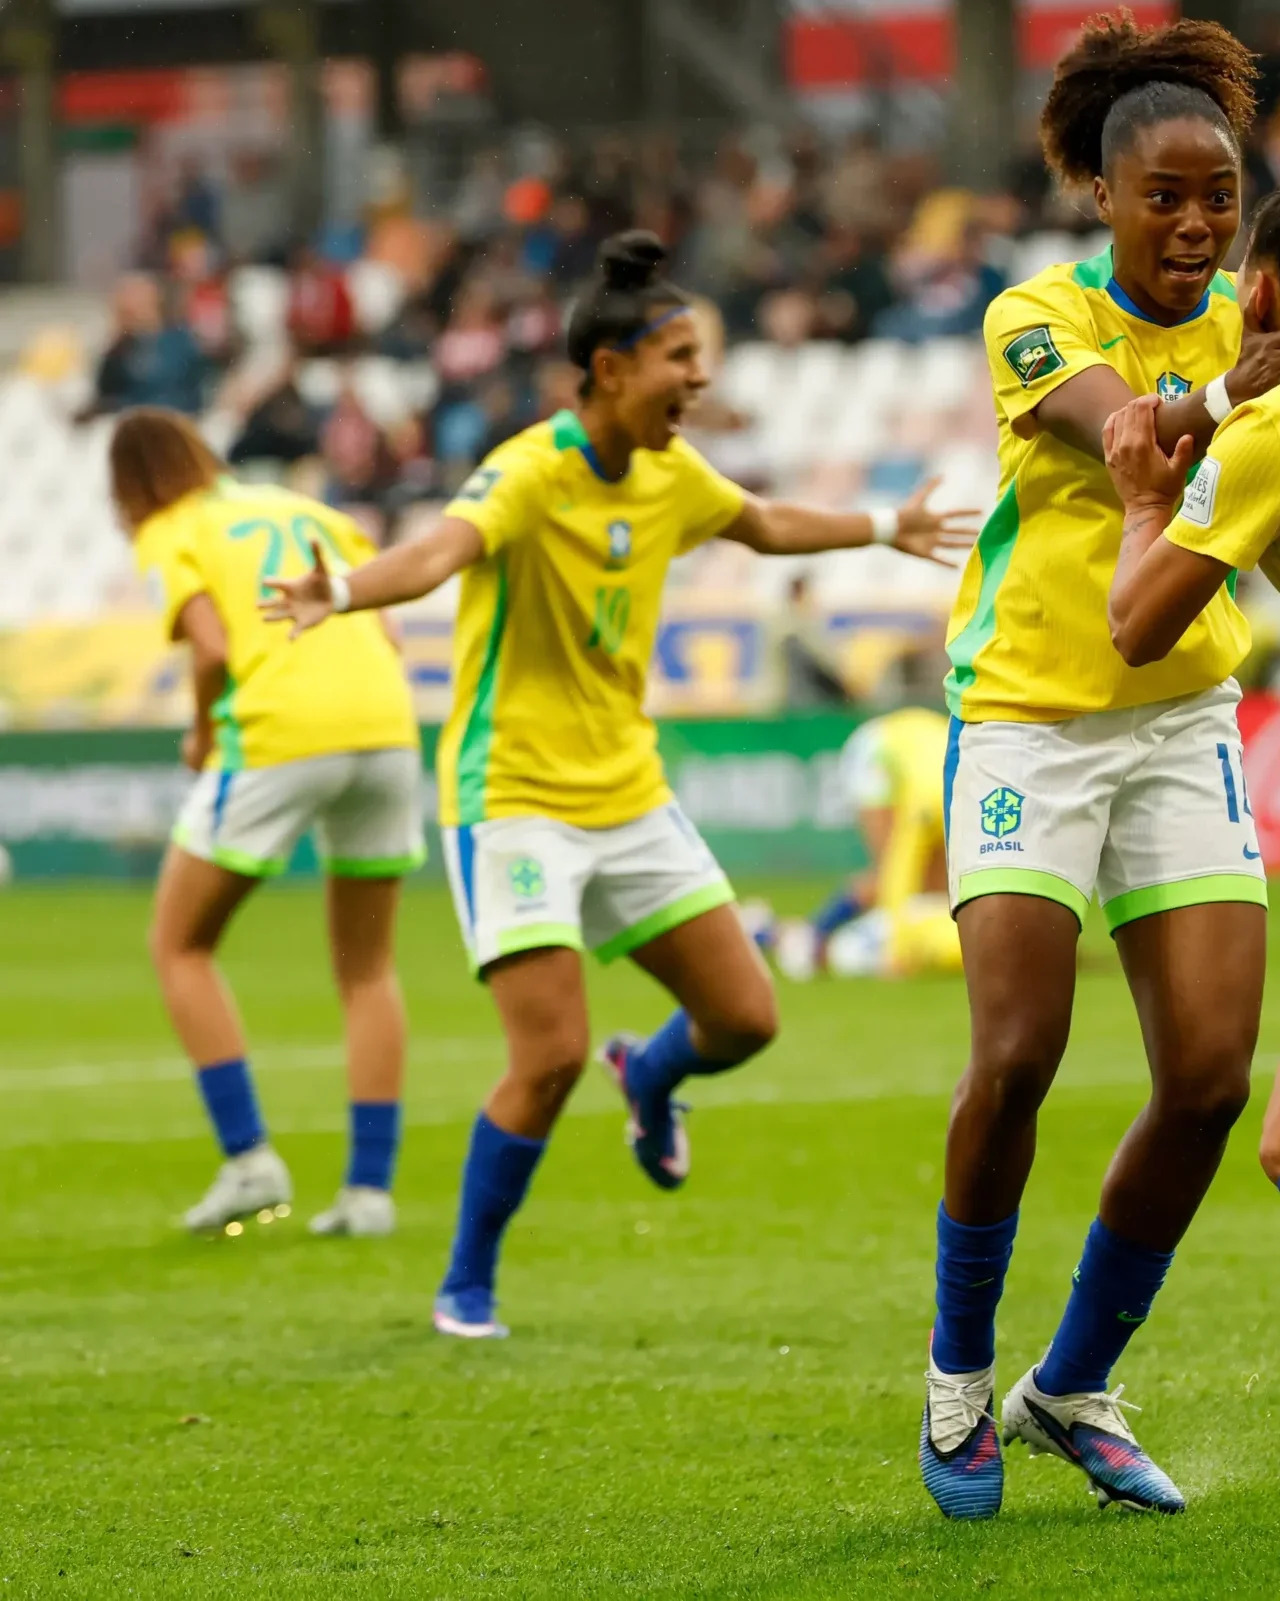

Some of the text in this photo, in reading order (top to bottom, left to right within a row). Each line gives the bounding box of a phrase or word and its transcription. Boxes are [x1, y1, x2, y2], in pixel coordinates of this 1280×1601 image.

[1164, 393, 1179, 401] CBF
[229, 514, 350, 602] 20
[588, 587, 630, 655] 10
[1216, 743, 1254, 823] 1
[992, 807, 1009, 815] CBF
[980, 841, 1024, 854] BRASIL
